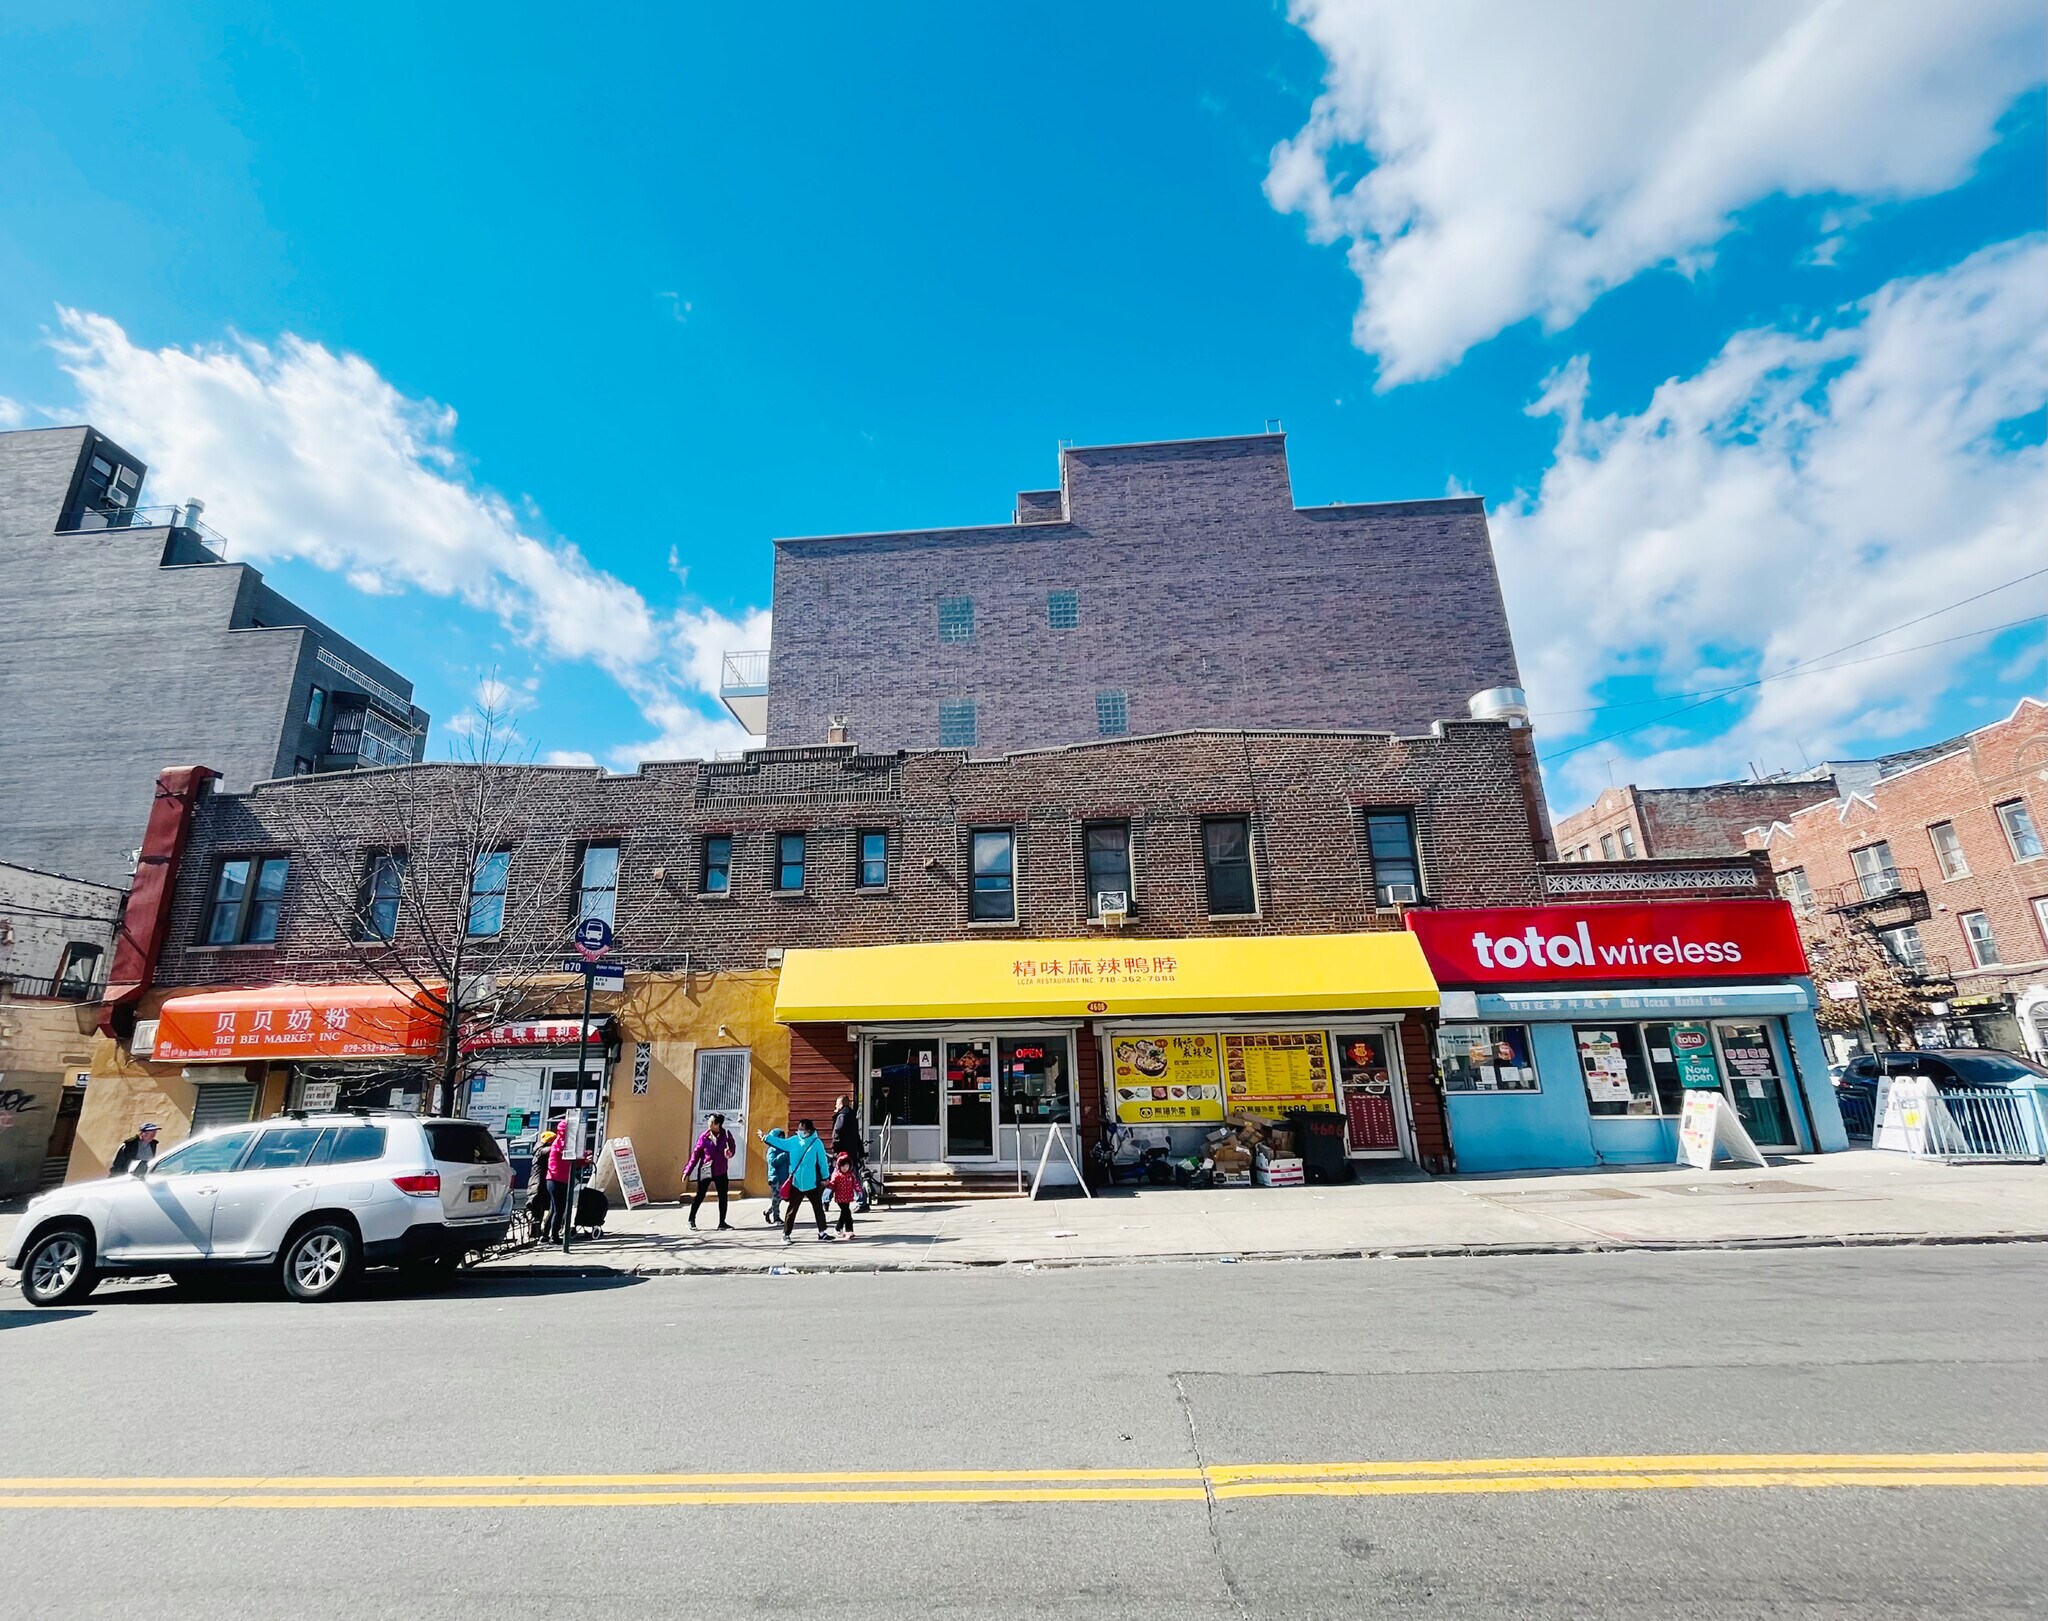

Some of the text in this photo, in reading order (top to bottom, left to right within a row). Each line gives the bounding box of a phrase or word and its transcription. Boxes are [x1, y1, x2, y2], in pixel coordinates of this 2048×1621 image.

[1472, 920, 1742, 968] total wireless
[564, 962, 581, 972] B70
[1674, 996, 1704, 1007] Market
[215, 1032, 341, 1045] BEI BEI MARKET INC
[1677, 1034, 1702, 1044] total
[921, 1053, 930, 1063] A
[1015, 1048, 1043, 1059] OPEN
[1685, 1065, 1710, 1074] Now
[1686, 1074, 1714, 1083] open
